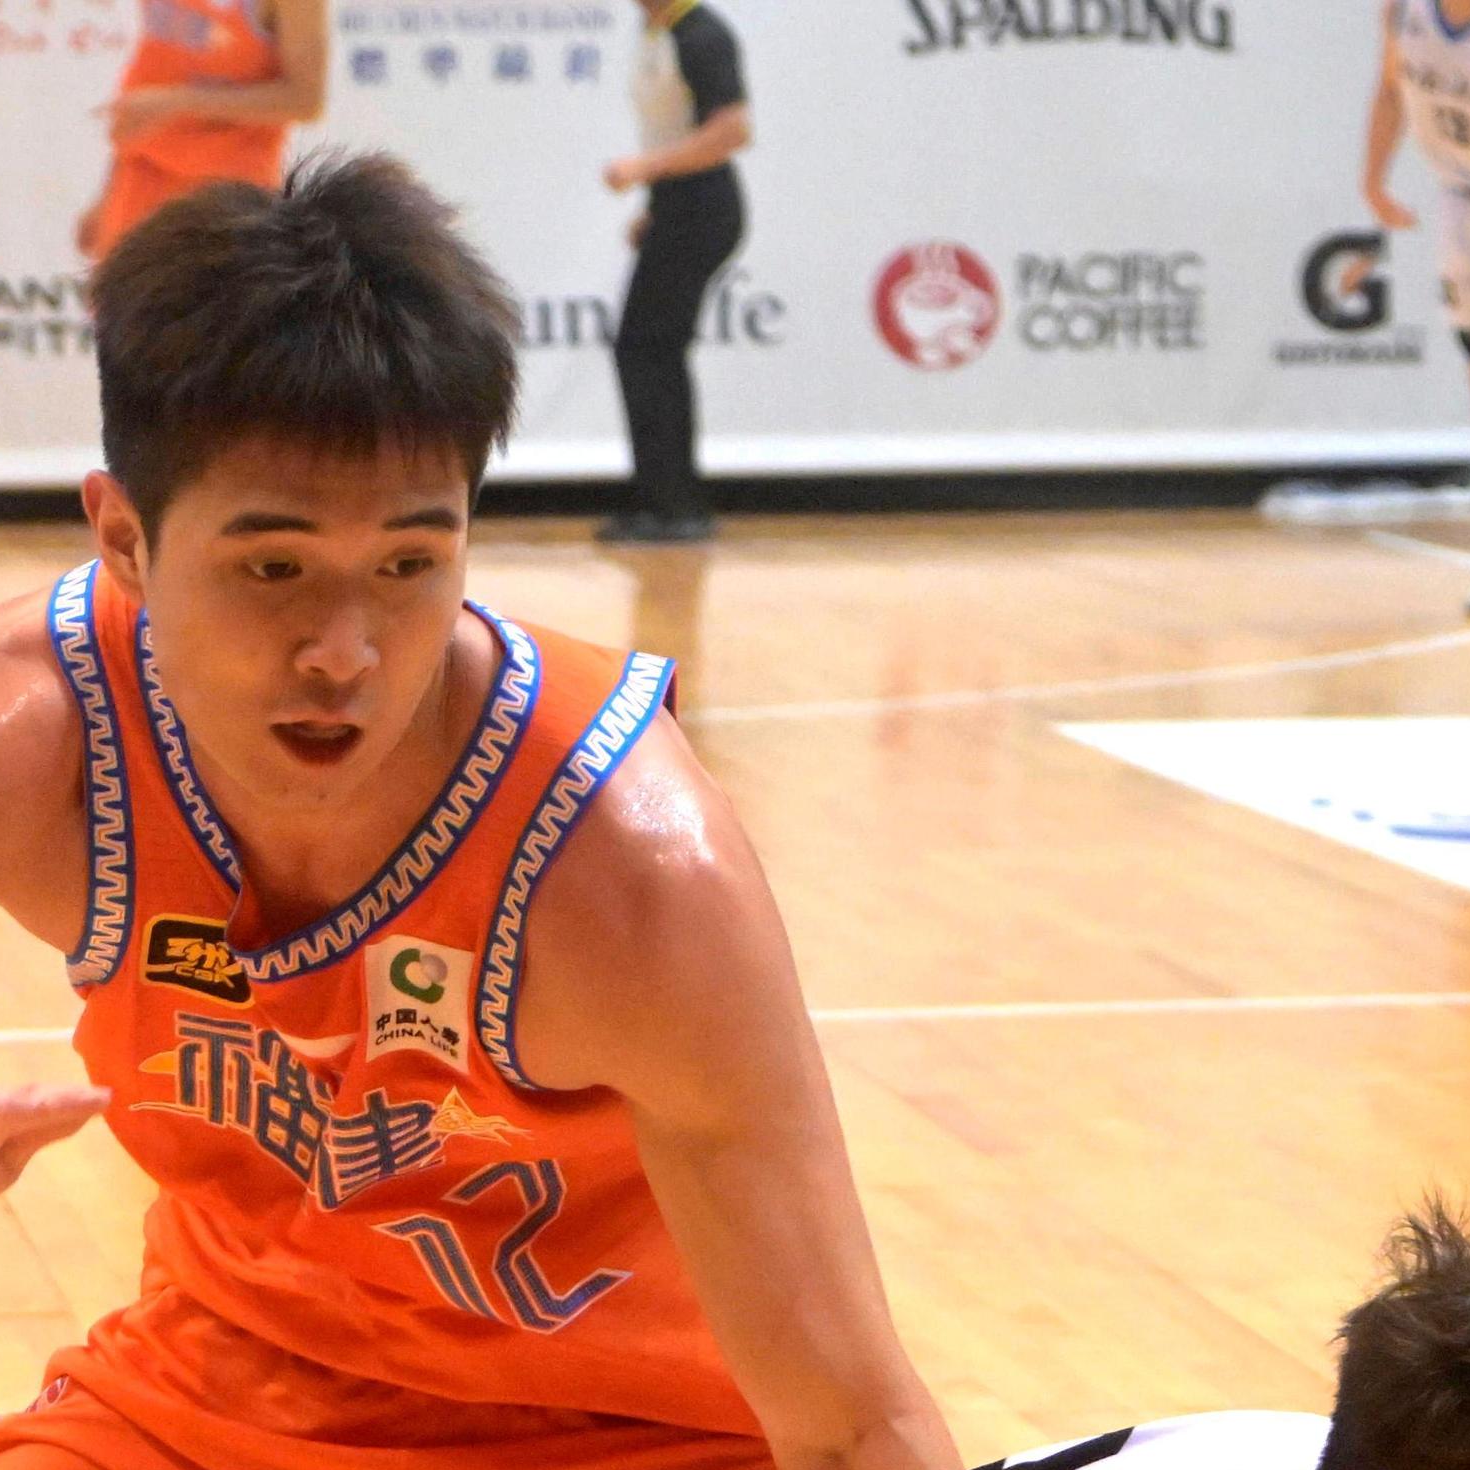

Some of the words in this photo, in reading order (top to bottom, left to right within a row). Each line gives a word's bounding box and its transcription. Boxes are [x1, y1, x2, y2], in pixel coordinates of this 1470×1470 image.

[1016, 252, 1205, 299] PACIFIC
[1016, 303, 1205, 350] COFFEE
[375, 1028, 426, 1045] CHINA
[371, 1157, 634, 1335] 12
